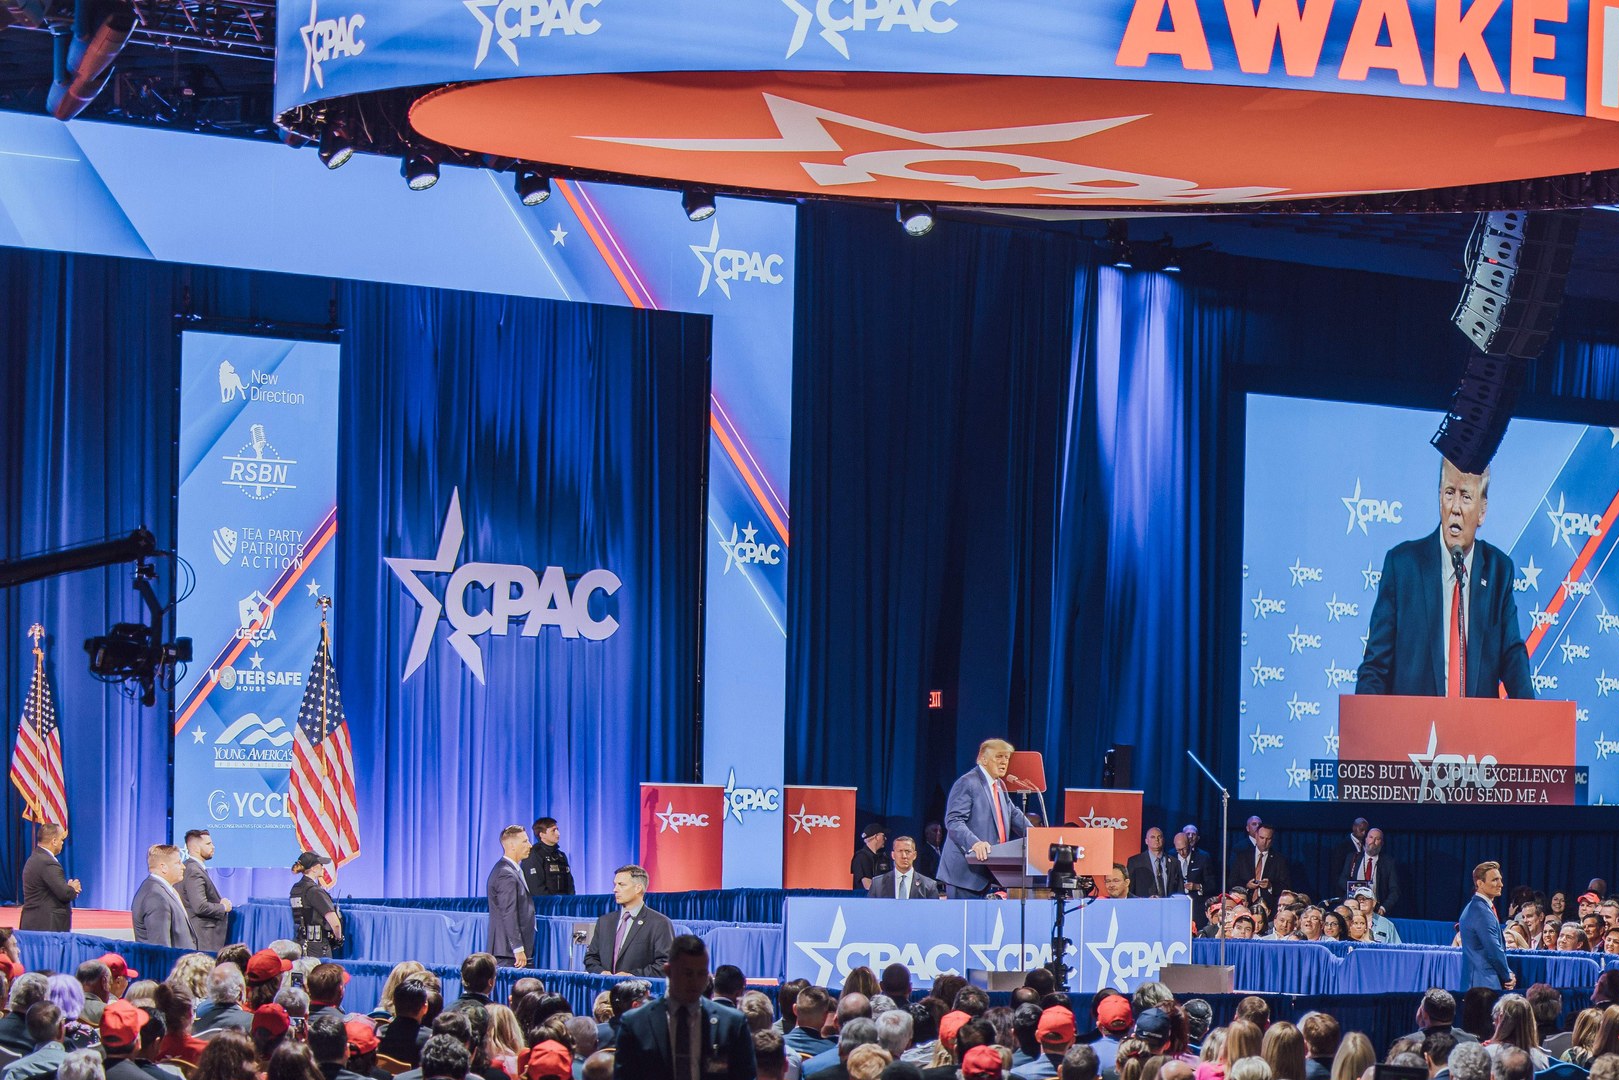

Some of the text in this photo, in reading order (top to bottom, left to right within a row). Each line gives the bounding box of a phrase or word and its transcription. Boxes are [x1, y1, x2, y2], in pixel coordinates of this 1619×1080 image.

[494, 0, 602, 40] CPAC
[816, 0, 959, 33] CPAC
[312, 13, 366, 63] CPAC
[1115, 0, 1568, 101] AWAKE
[713, 248, 784, 285] CPAC
[251, 369, 279, 385] New
[251, 386, 304, 405] Direction
[230, 462, 288, 484] RSBN
[1357, 499, 1402, 523] CPAC
[1560, 512, 1602, 536] CPAC
[242, 527, 304, 542] TEA PARTY
[241, 542, 304, 558] PATRIOTS
[734, 543, 780, 566] CPAC
[241, 556, 304, 570] ACTION
[1297, 567, 1323, 581] CPAC
[1569, 582, 1591, 596] CPAC
[445, 562, 622, 640] CPAC
[1260, 599, 1286, 613] CPAC
[1334, 602, 1359, 616] CPAC
[1536, 611, 1559, 626] CPAC
[236, 628, 277, 641] USCCA
[1297, 634, 1322, 648] CPAC
[1567, 644, 1591, 659] CPAC
[266, 671, 302, 686] SAFE
[1259, 667, 1285, 681] CPAC
[1332, 668, 1358, 683] CPAC
[1535, 675, 1558, 689] CPAC
[1295, 701, 1320, 715] CPAC
[1258, 735, 1284, 748] CPAC
[1314, 763, 1567, 783] HE GOES BUT WHY YOUR EXCELLENCY
[1431, 754, 1498, 788] CPAC
[730, 788, 778, 811] CPAC
[1313, 784, 1549, 803] MR. PRESIDENT DO YOU SEND ME A
[669, 813, 709, 828] CPAC
[801, 814, 840, 828] CPAC
[1090, 816, 1128, 830] CPAC
[836, 942, 961, 982] CPAC
[1112, 941, 1188, 978] CPAC
